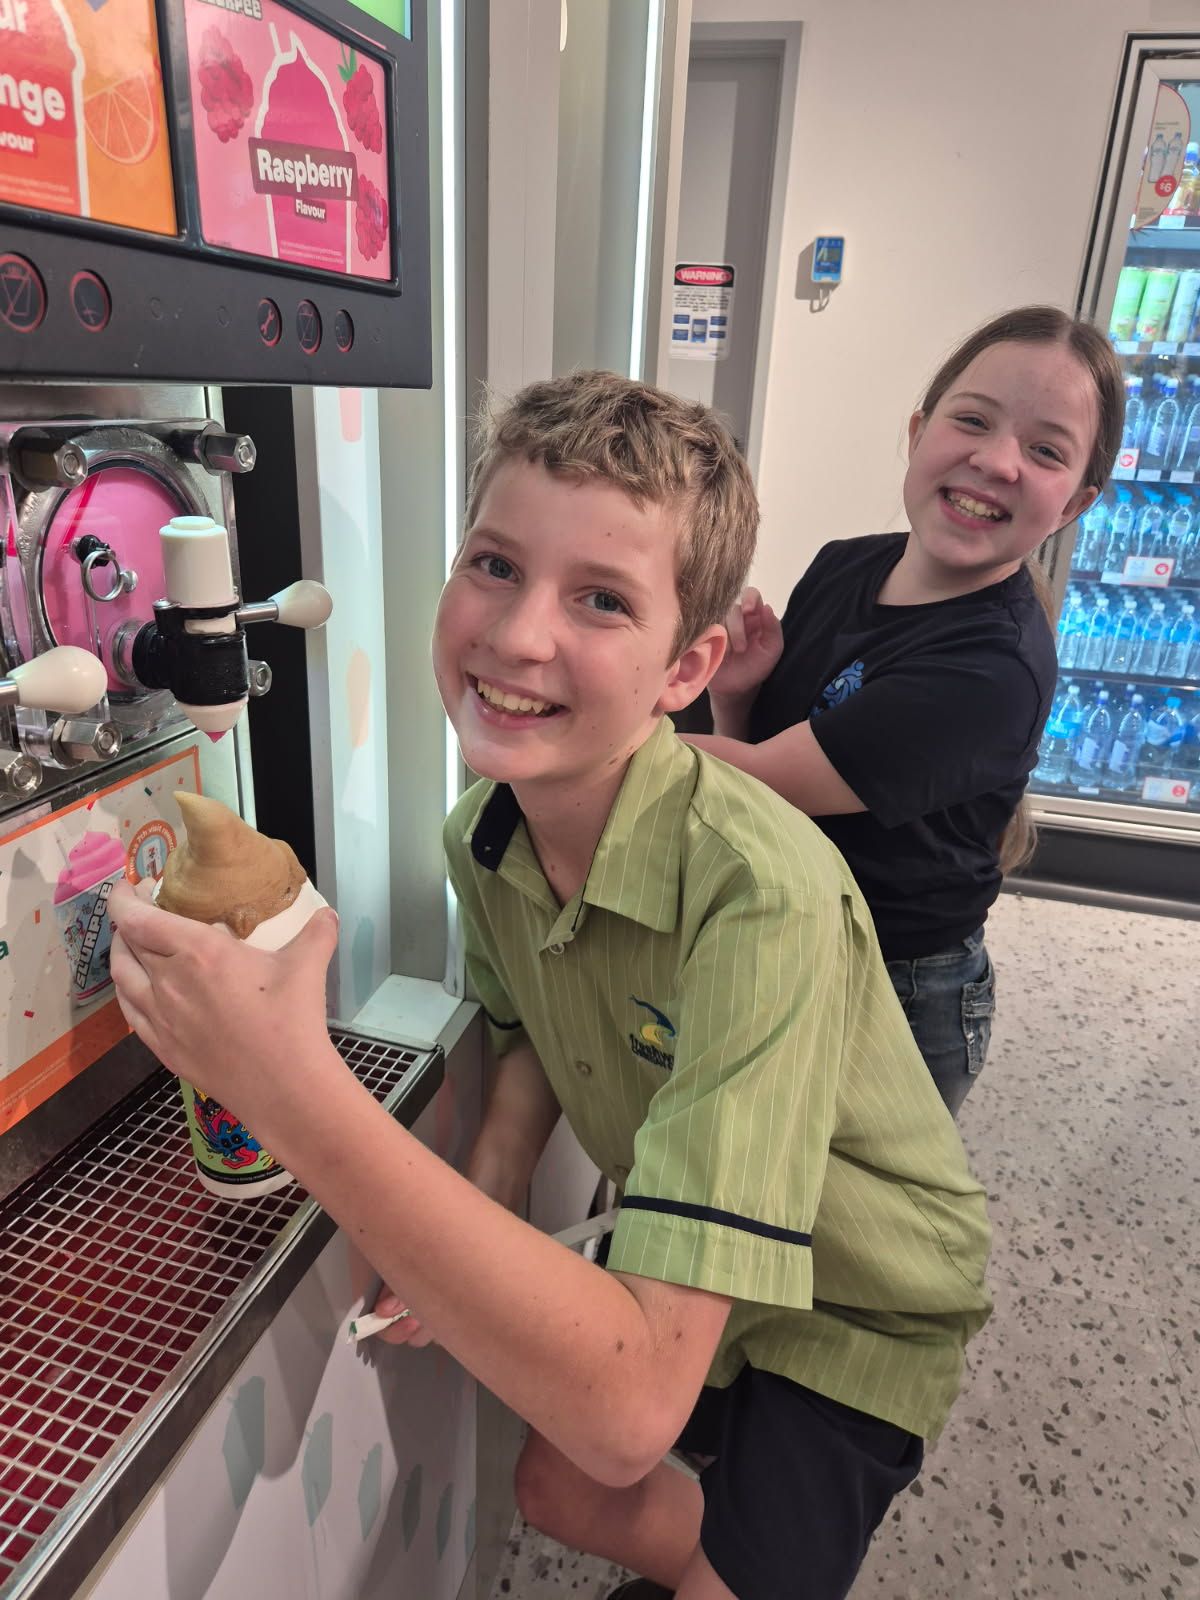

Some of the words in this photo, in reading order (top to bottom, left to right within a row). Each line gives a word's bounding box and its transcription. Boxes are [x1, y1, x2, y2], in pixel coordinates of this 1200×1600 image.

[0, 73, 66, 126] nge
[257, 148, 353, 197] Raspberry
[296, 199, 325, 219] Flavour
[680, 269, 727, 281] WARNING
[149, 824, 163, 833] visit
